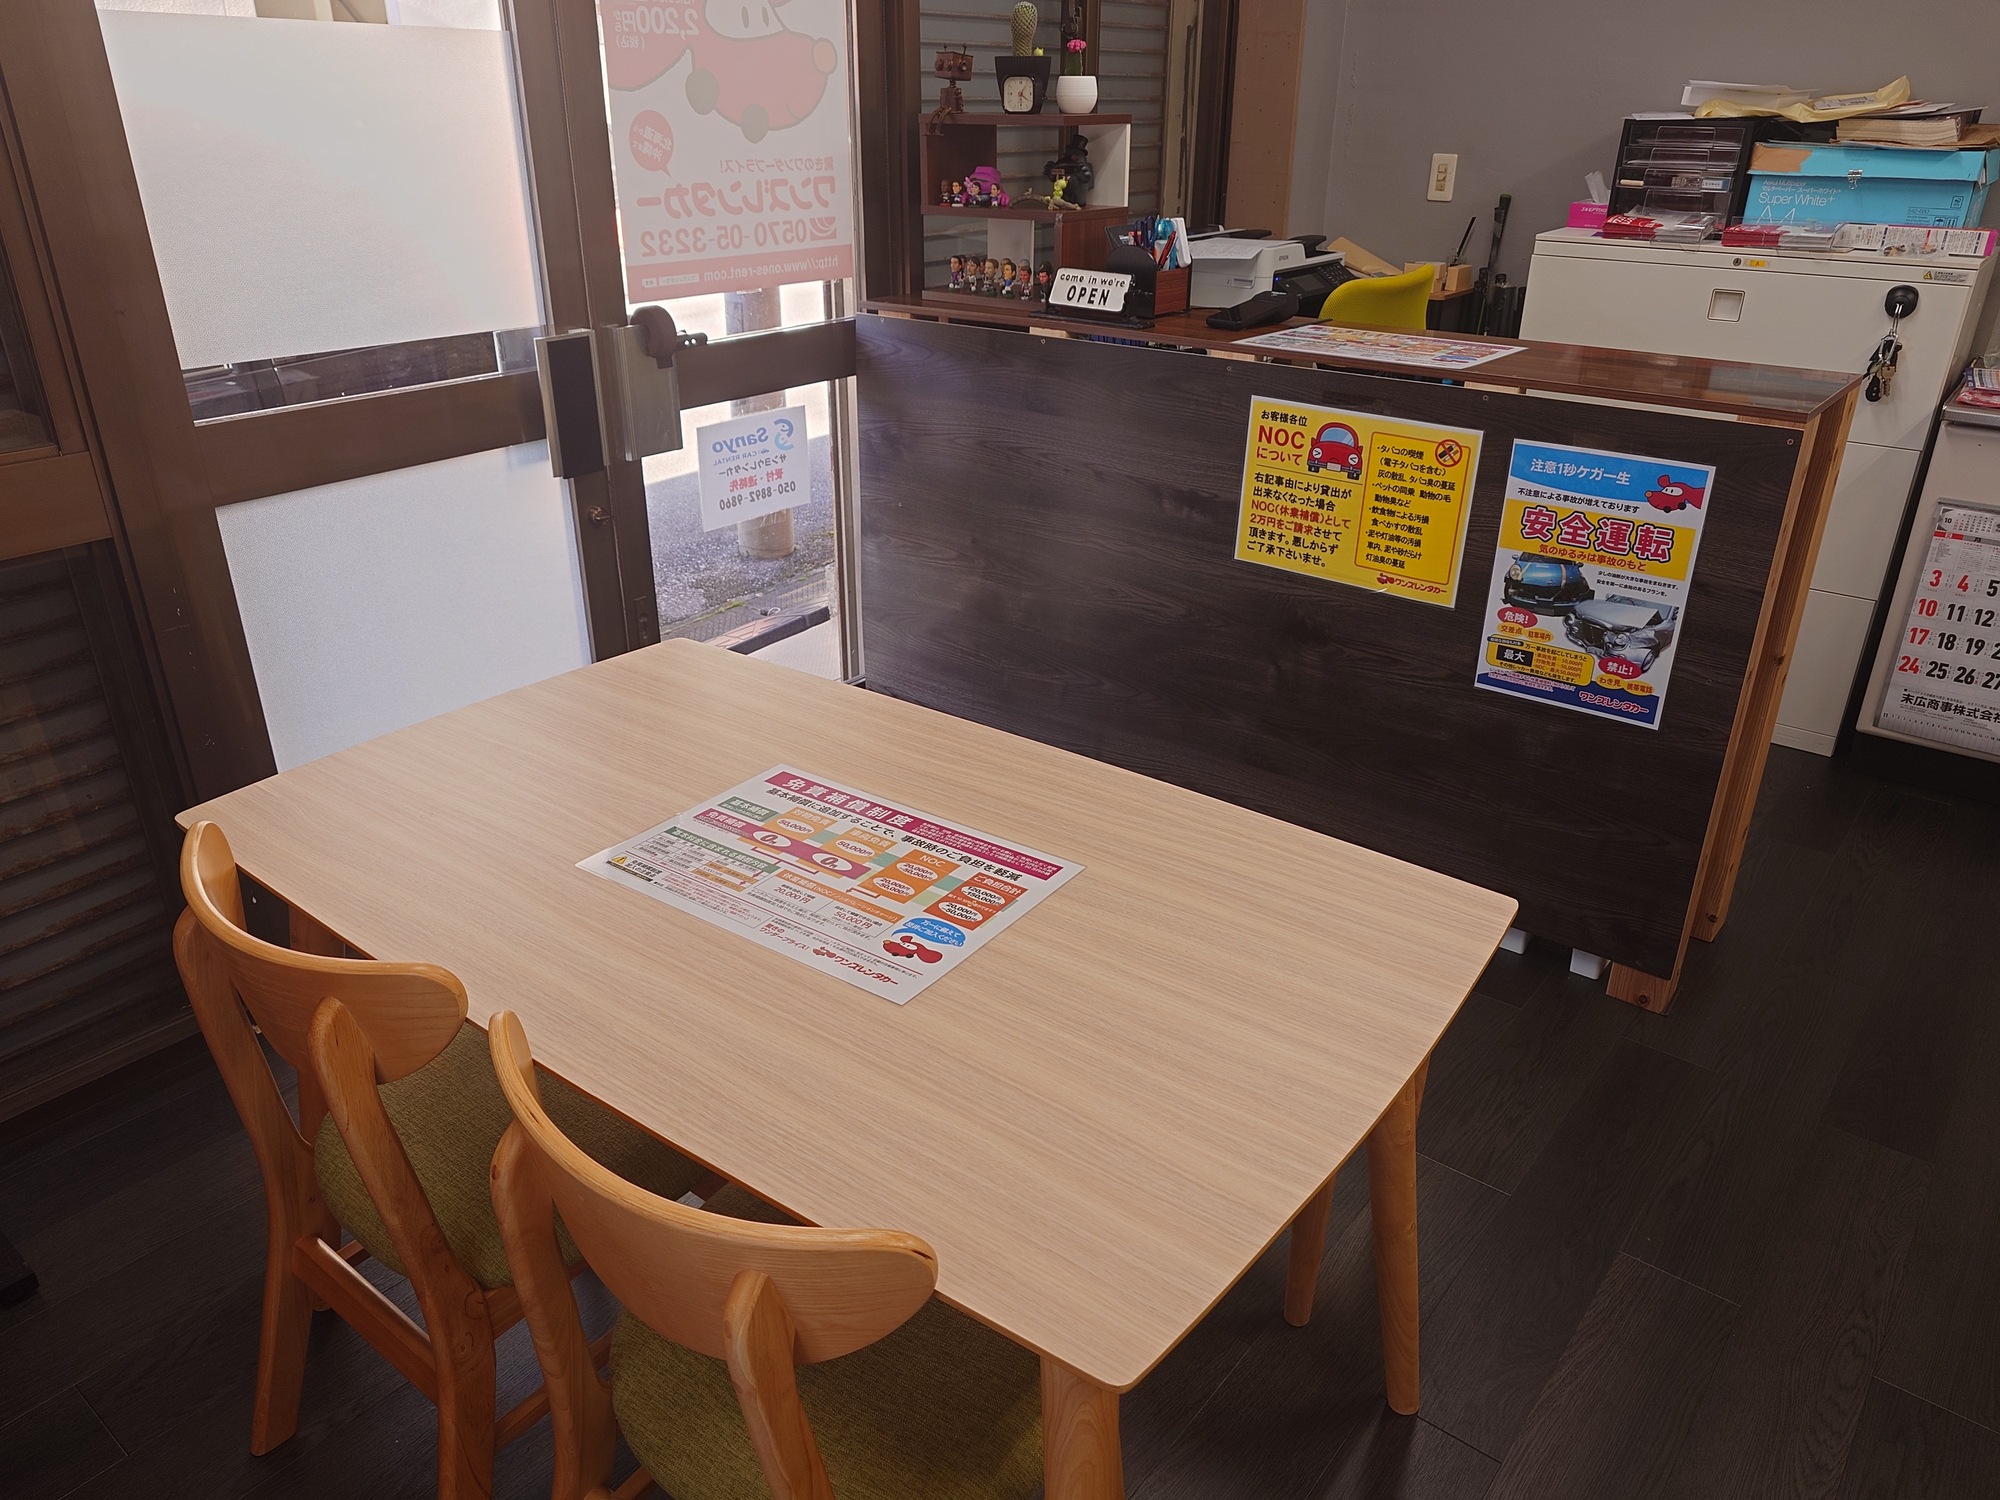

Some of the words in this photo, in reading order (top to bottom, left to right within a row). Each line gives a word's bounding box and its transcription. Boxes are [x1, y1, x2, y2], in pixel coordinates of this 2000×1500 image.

[1759, 192, 1791, 205] Super
[1060, 274, 1084, 282] come
[1088, 276, 1096, 284] in
[1100, 278, 1125, 287] we're
[1067, 285, 1110, 306] OPEN
[1260, 409, 1308, 426] お客様各位
[1257, 424, 1306, 450] NOC
[1256, 446, 1302, 466] について
[1529, 457, 1632, 486] 注意1秒ケガ一生
[1252, 485, 1336, 512] 出来なくなった場合
[1253, 471, 1352, 500] 右記事由により貸出が
[1517, 486, 1640, 514] 不注意による事故が増えております
[1249, 512, 1342, 542] 2万円をご請求させて
[1519, 503, 1676, 564] 安全運転
[1246, 539, 1326, 567] ご了承下さいませ。
[1248, 526, 1338, 555] 頂きます。悪しからず
[1538, 543, 1646, 572] 気のゆるみは事故のもと
[1394, 577, 1447, 597] ワンズレンタカー
[1930, 570, 1942, 587] 3
[1957, 575, 1969, 592] 4
[1987, 580, 2000, 596] 5
[1503, 610, 1529, 624] 危険!
[1918, 598, 1938, 617] 10
[1947, 604, 1965, 622] 11
[1975, 609, 1995, 627] 12
[1500, 624, 1523, 635] 交差点
[1527, 629, 1551, 641] 駐車場内
[1909, 627, 1930, 645] 17
[1938, 632, 1956, 650] 18
[1966, 638, 1985, 655] 19
[1503, 648, 1525, 662] 最大
[1524, 643, 1588, 662] 万一事故を起こしてしまうと
[1606, 661, 1634, 676] 禁止!
[1898, 655, 1919, 674] 24
[1926, 661, 1949, 679] 25
[1954, 666, 1976, 685] 26
[1598, 675, 1622, 688] わき見
[1626, 681, 1653, 695] 携帯電話
[1578, 690, 1650, 716] ワンズレンタカー
[780, 777, 916, 827] 免責補償制度
[703, 810, 748, 828] 免責補償
[776, 818, 814, 834] 50,000円
[834, 840, 875, 856] 50,000円
[917, 854, 947, 867] NOC
[830, 955, 901, 986] ワンズレンタカー
